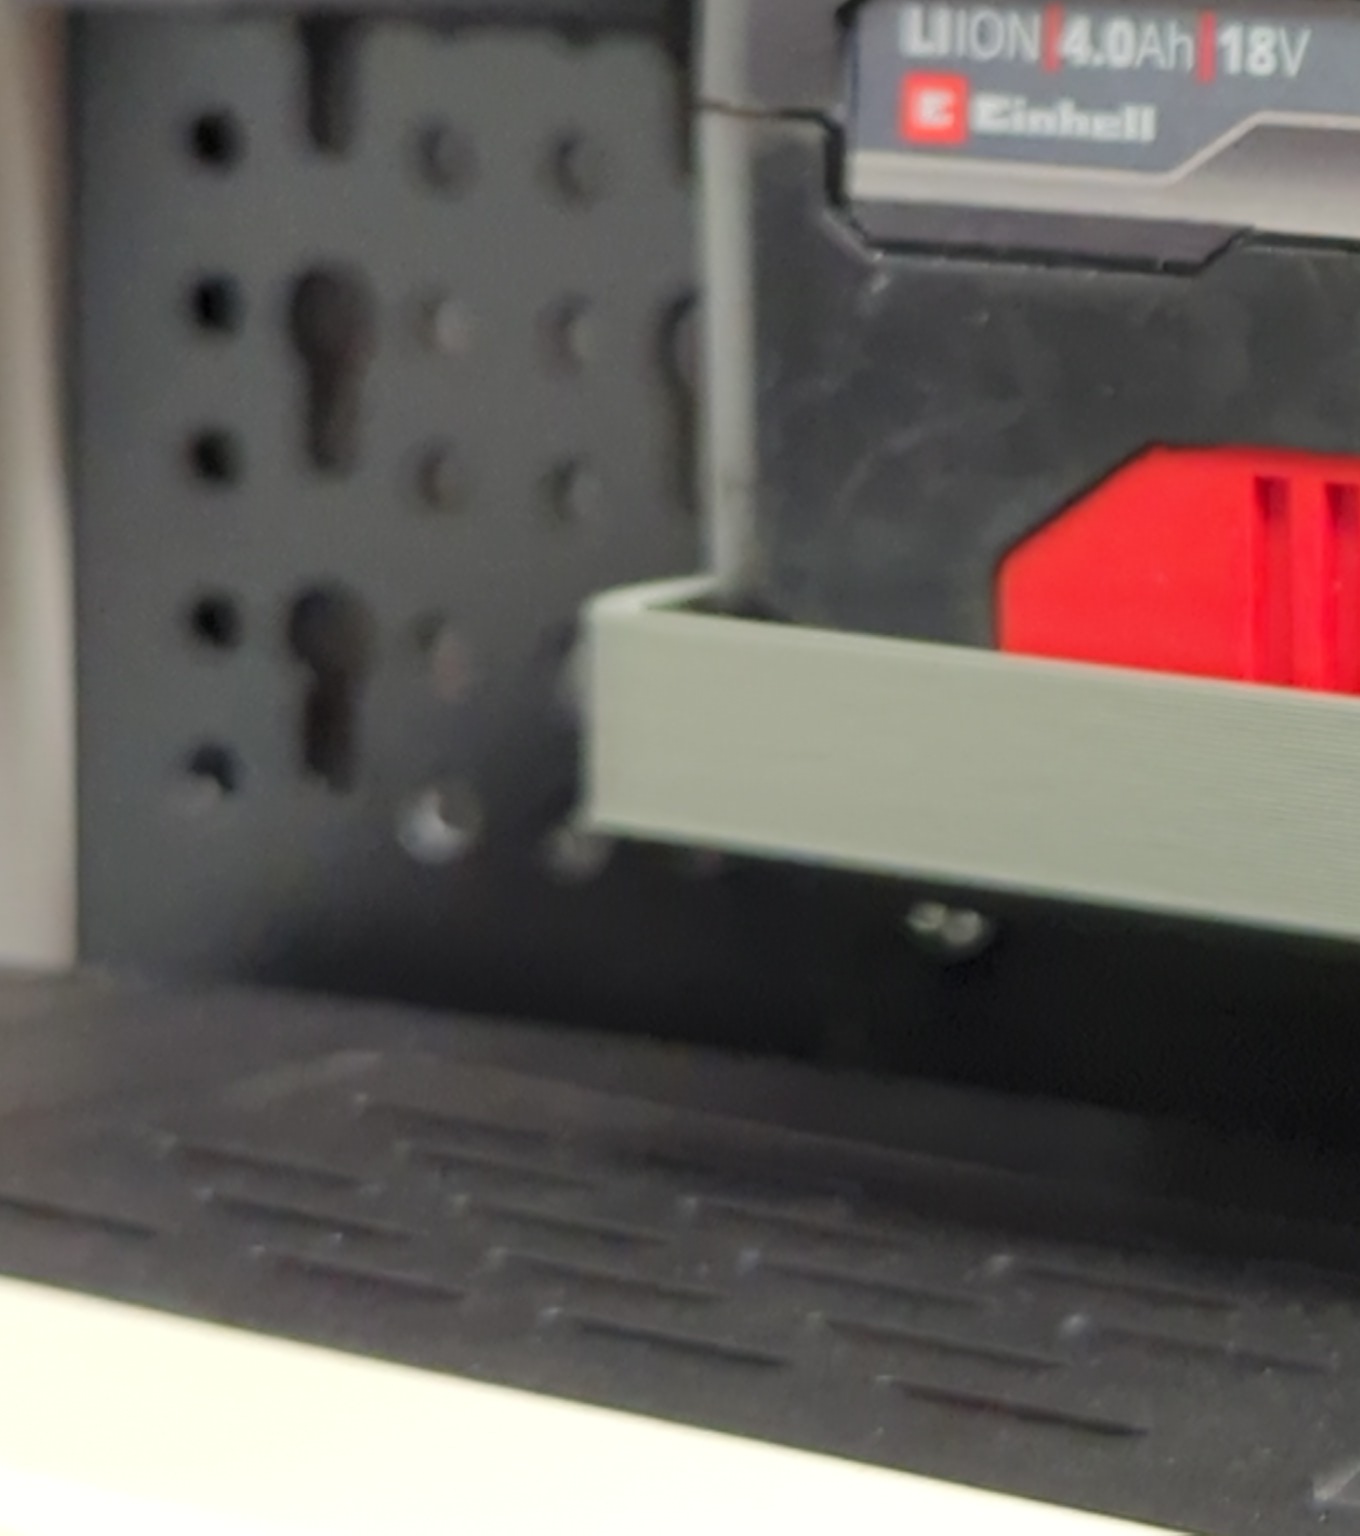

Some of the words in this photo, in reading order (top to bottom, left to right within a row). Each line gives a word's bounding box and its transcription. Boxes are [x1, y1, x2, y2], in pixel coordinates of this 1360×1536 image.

[1061, 13, 1195, 70] 4.0Ah
[1218, 21, 1312, 77] 18V
[970, 89, 1158, 143] Einhell
